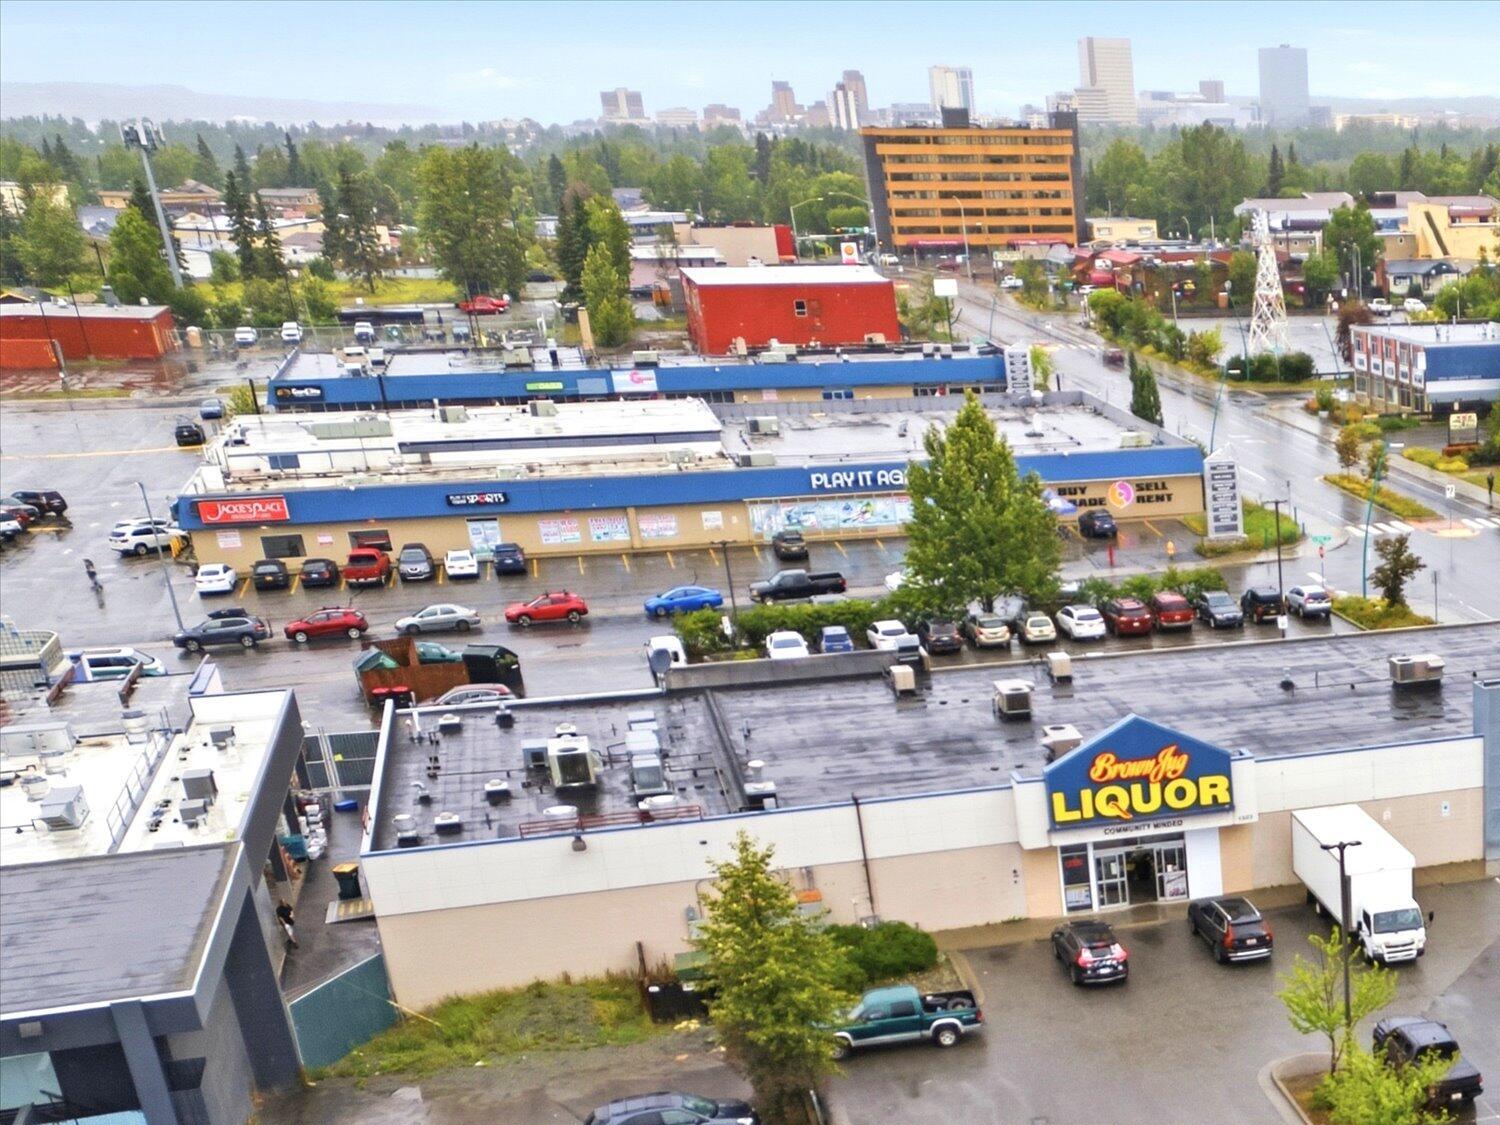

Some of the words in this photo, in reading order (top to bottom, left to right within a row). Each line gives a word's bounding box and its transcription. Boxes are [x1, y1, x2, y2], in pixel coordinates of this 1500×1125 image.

[811, 471, 855, 489] PLAY
[858, 470, 873, 486] IT
[1057, 485, 1088, 496] BUY
[1135, 481, 1169, 491] SELL
[1071, 496, 1108, 508] RADE
[1136, 492, 1174, 504] RENT
[1090, 753, 1156, 783] Brown
[1149, 745, 1189, 782] Jug
[1052, 774, 1231, 823] LIQUOR
[1104, 824, 1151, 836] COMMUNITY
[1153, 819, 1184, 831] MINDED
